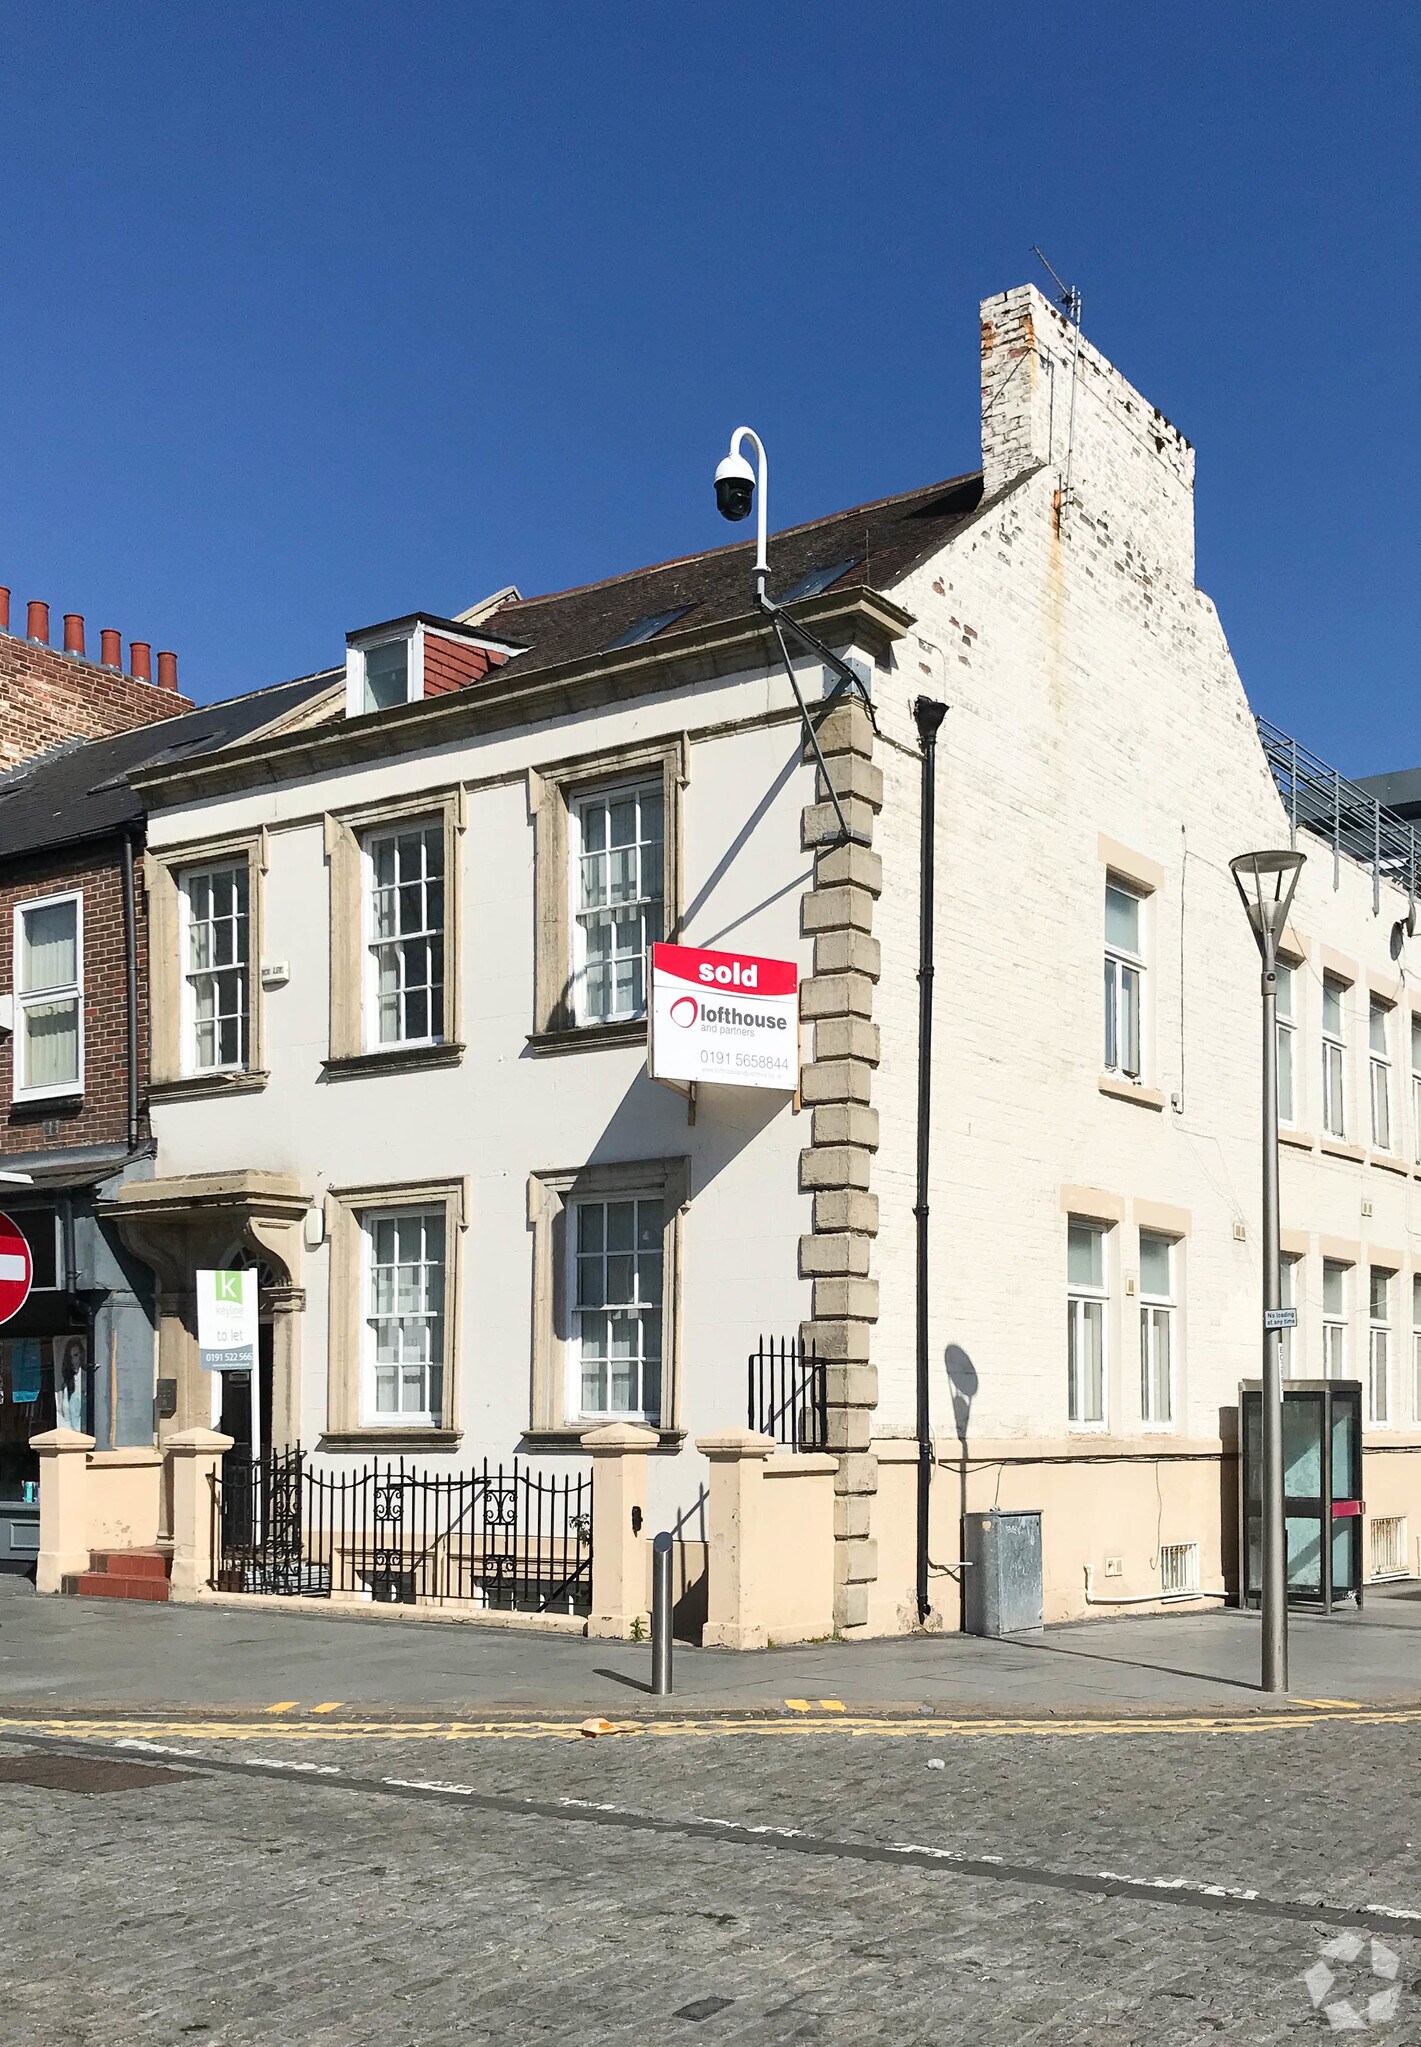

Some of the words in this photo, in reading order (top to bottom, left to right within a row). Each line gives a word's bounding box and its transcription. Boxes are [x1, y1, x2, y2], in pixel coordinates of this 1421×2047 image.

[698, 962, 758, 988] sold
[700, 1004, 787, 1030] lofthouse
[701, 1024, 717, 1033] and
[719, 1025, 755, 1037] partners
[700, 1050, 730, 1065] 0191
[736, 1053, 788, 1070] 5658844
[217, 1330, 227, 1342] to
[230, 1329, 244, 1341] let
[205, 1353, 223, 1362] 0191
[224, 1352, 238, 1361] 522
